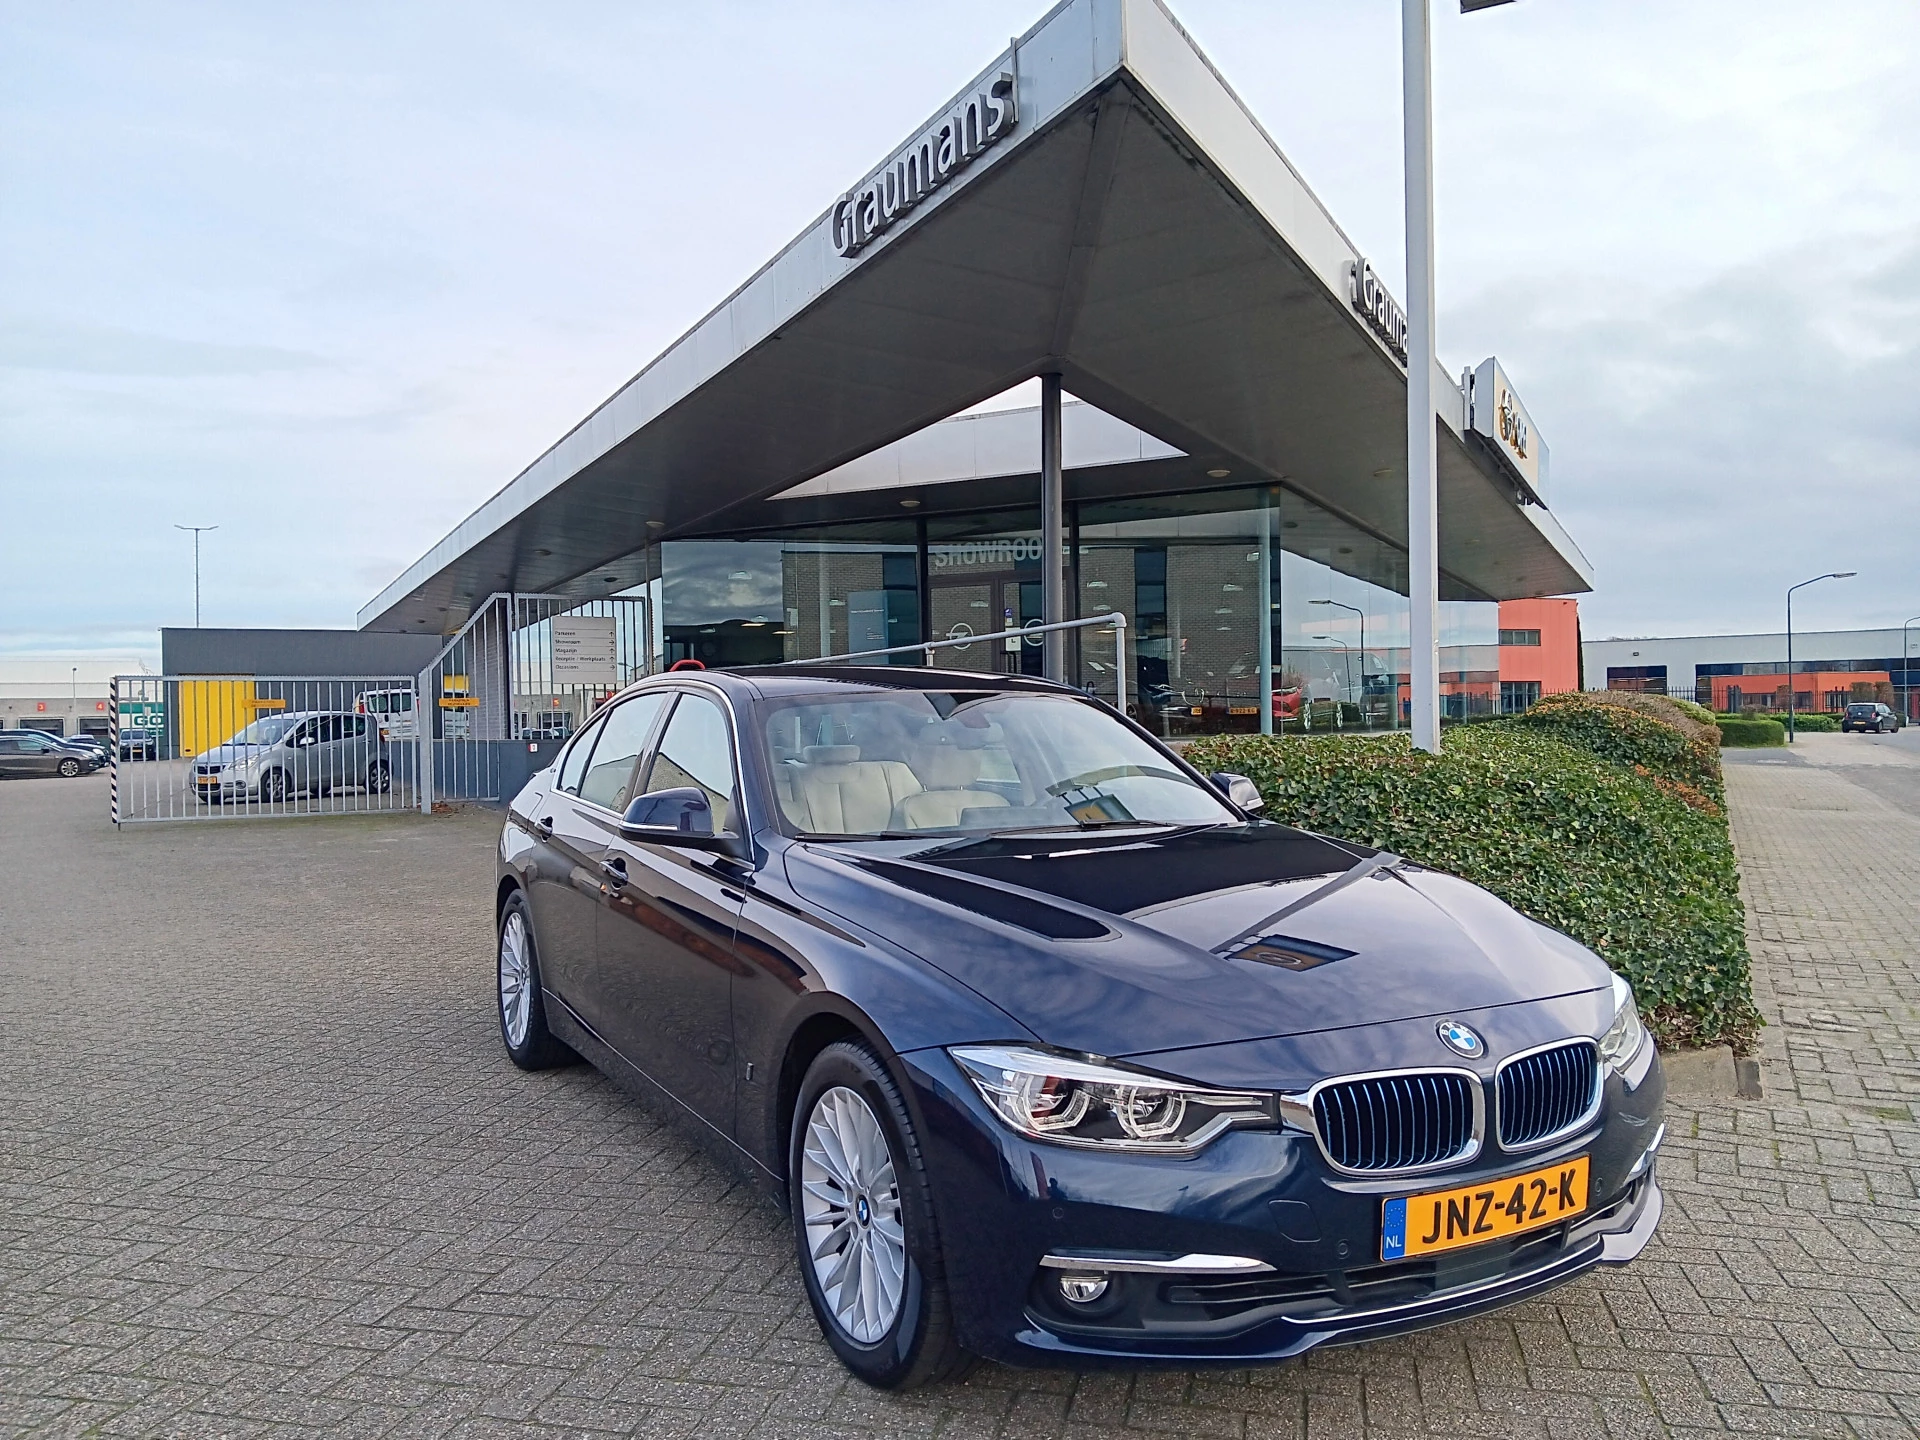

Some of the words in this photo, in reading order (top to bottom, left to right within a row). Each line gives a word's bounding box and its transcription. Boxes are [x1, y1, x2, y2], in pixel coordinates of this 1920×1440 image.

[832, 72, 1017, 257] Graumans
[934, 536, 1042, 567] SHOWROO
[1422, 1168, 1576, 1244] JNZ-42-K
[1385, 1235, 1402, 1249] NL
